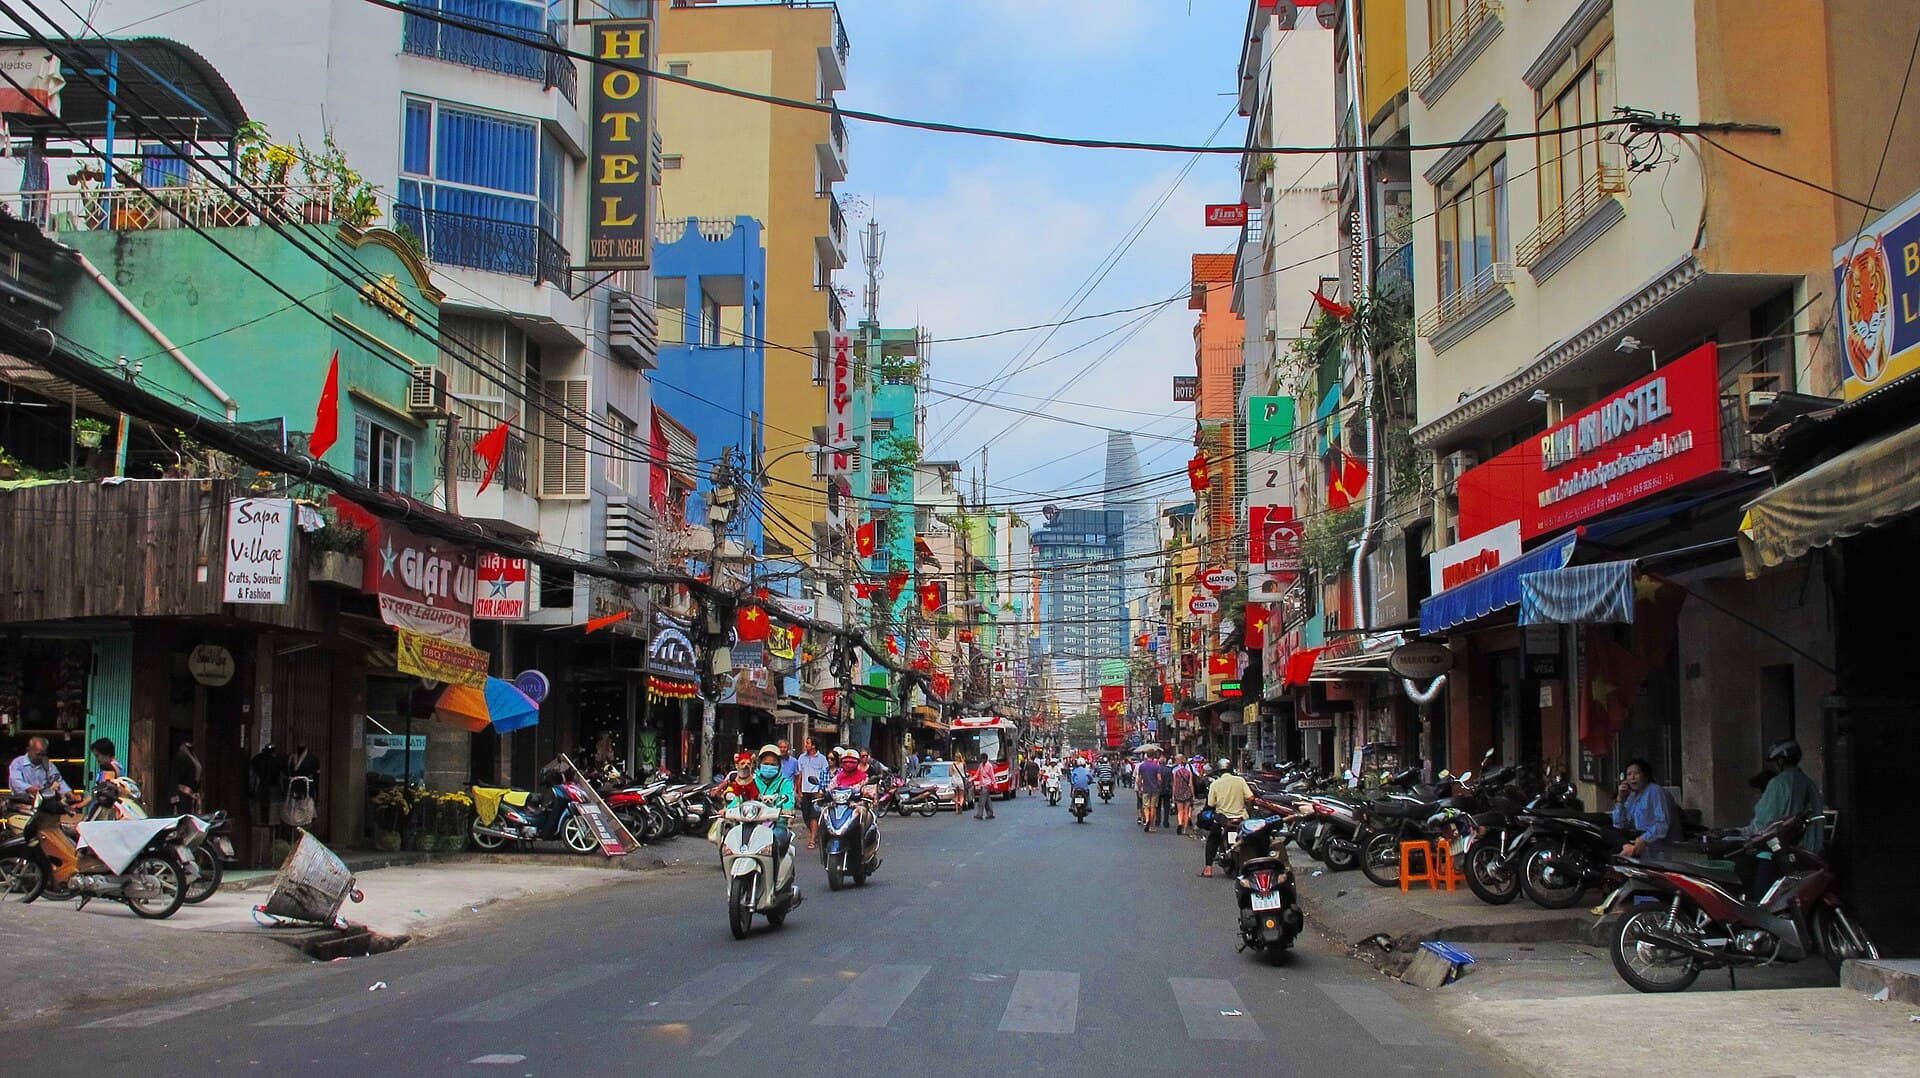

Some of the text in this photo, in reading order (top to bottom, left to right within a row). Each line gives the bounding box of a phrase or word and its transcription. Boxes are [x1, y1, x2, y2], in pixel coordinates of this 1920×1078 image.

[600, 29, 645, 226] HOTEL
[1209, 207, 1244, 221] Jim's
[591, 235, 643, 262] VIỆT NGHI
[1903, 242, 1920, 277] B
[1902, 292, 1920, 323] L
[834, 336, 848, 470] HAPPY IN
[1601, 377, 1672, 443] HOSTEL
[1263, 402, 1279, 523] PIZZ
[237, 502, 280, 535] Sapa
[230, 537, 283, 575] Village
[228, 571, 282, 585] Crafts, Souvenir
[237, 587, 271, 600] & Fashion
[1207, 575, 1236, 583] HOTEL
[381, 597, 469, 631] STAR LAUNDRY
[476, 599, 523, 617] STAR LAUNDRY
[1194, 602, 1217, 610] HOTEL
[423, 647, 441, 659] BBQ
